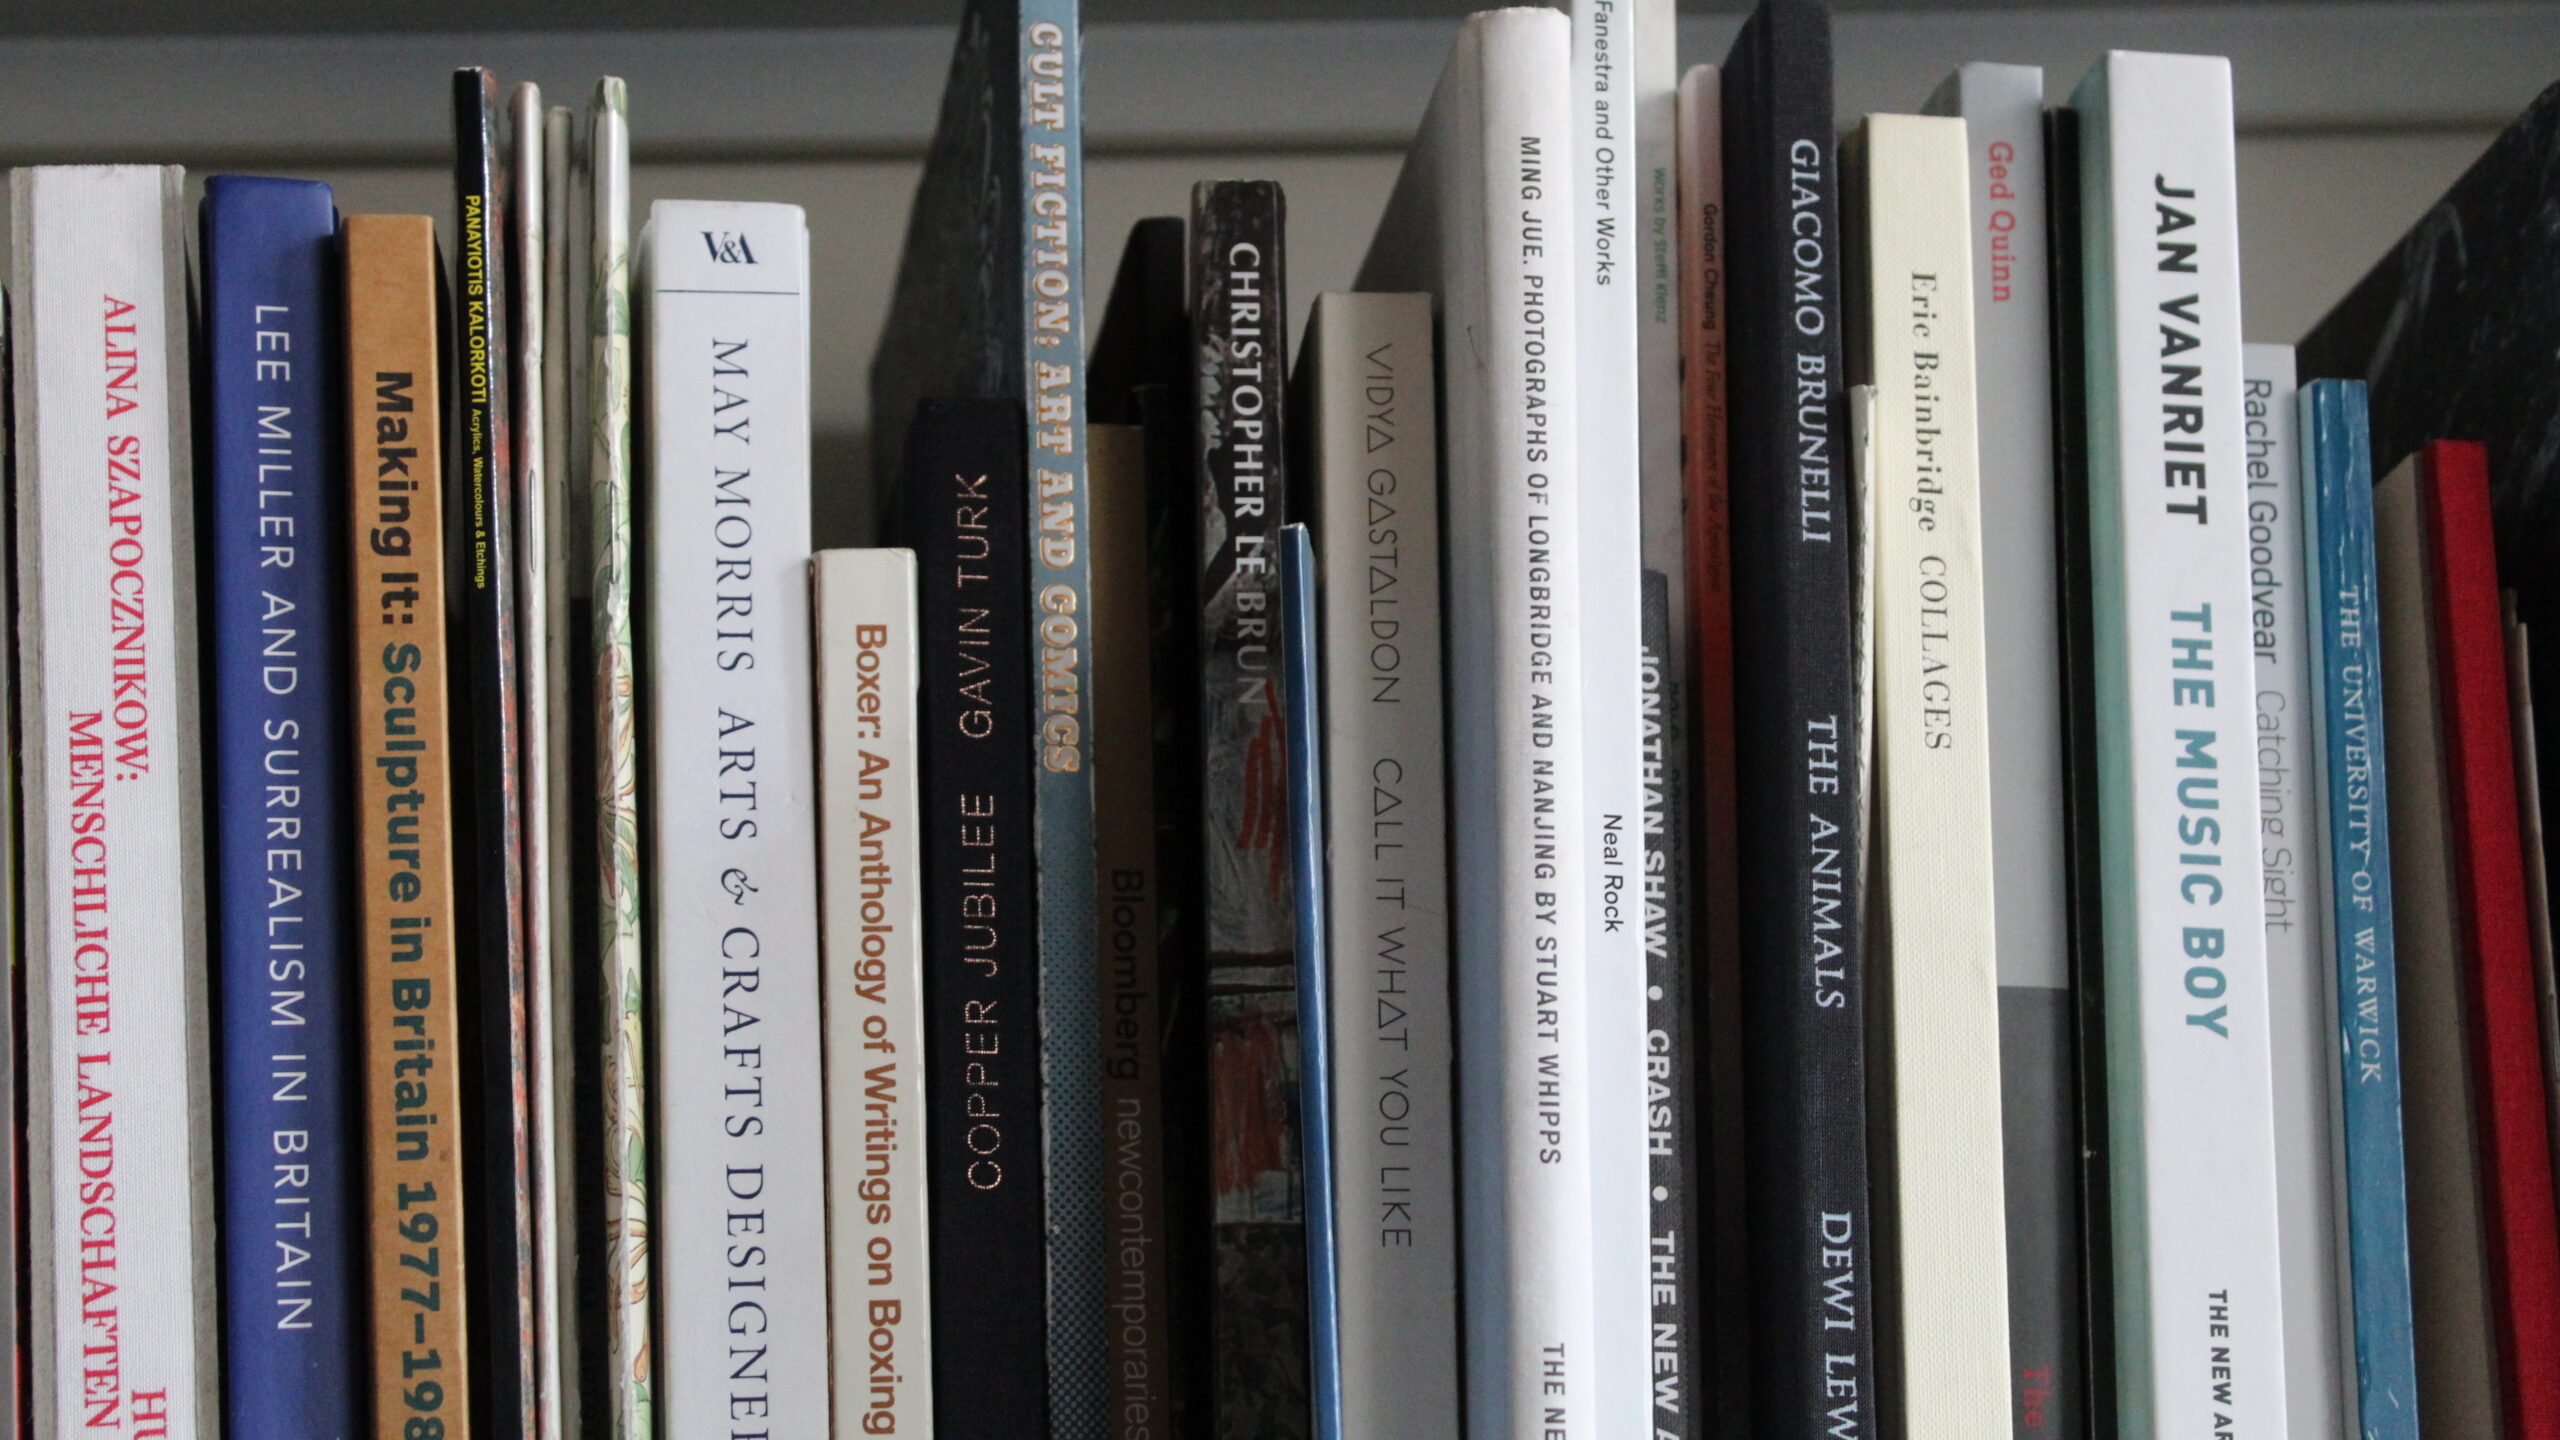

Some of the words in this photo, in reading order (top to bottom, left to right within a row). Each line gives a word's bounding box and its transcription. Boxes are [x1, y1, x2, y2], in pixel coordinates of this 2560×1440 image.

[1029, 21, 1064, 130] CULT
[1595, 0, 1613, 91] Fanestra
[1521, 136, 1542, 200] MING
[1595, 101, 1613, 140] and
[1988, 141, 2014, 199] Ged
[1595, 147, 1615, 210] Other
[1653, 168, 1667, 212] Works
[1653, 217, 1667, 236] by
[2155, 173, 2198, 273] JAN
[466, 195, 483, 295] PANAYIOTIS
[701, 231, 758, 264] V&A
[1031, 143, 1069, 347] FICTION:
[1522, 210, 1542, 265] JUE.
[1596, 218, 1616, 286] Works
[1703, 203, 1717, 263] Gordon
[1790, 138, 1825, 337] GIACOMO
[1988, 210, 2017, 302] Quinn
[255, 305, 290, 382] LEE
[468, 302, 487, 402] KALORKOTI
[1703, 269, 1718, 331] Cheung
[1911, 271, 1938, 337] Eric
[104, 294, 137, 419] ALINA
[712, 338, 750, 446] MAY
[1035, 361, 1073, 455] ART
[1229, 241, 1264, 518] CHRISTOPHER
[1523, 274, 1548, 462] PHOTOGRAPHS
[2159, 293, 2208, 525] VANRIET
[371, 371, 418, 557] Making
[471, 409, 483, 455] Acrylics,
[1797, 354, 1831, 543] BRUNELLI
[1910, 352, 1945, 533] Bainbridge
[2243, 378, 2279, 492] Rachel
[257, 406, 295, 569] MILLER
[473, 457, 484, 528] Watercolours
[955, 473, 988, 587] TURK
[1038, 468, 1075, 569] AND
[1527, 472, 1548, 505] OF
[107, 434, 149, 781] SZAPOCZNIKOW:
[381, 573, 420, 625] It:
[475, 542, 486, 588] Etchings
[714, 468, 754, 671] MORRIS
[1234, 535, 1265, 575] LE
[1528, 514, 1552, 684] LONGBRIDGE
[261, 591, 298, 695] AND
[1236, 592, 1268, 705] BRUN
[1919, 555, 1952, 751] COLLAGES
[2170, 602, 2215, 708] THE
[2339, 586, 2361, 648] THE
[856, 624, 887, 739] Boxer:
[958, 607, 992, 738] GAVIN
[1040, 583, 1080, 772] COMICS
[1532, 695, 1553, 748] AND
[376, 642, 426, 902] Sculpture
[717, 707, 757, 840] ARTS
[858, 750, 890, 799] An
[1641, 645, 1665, 836] JONATHAN
[1807, 714, 1839, 795] THE
[2255, 690, 2291, 838] Catching
[2341, 665, 2370, 858] UNIVERSITY
[1532, 759, 1556, 880] NANJING
[1603, 814, 1623, 865] Neal
[2175, 730, 2224, 907] MUSIC
[70, 710, 110, 1035] MENSCHLICHE
[264, 719, 306, 1027] SURREALISM
[720, 868, 759, 905] &
[854, 811, 893, 1004] Anthology
[961, 794, 996, 977] JUBILEE
[1376, 879, 1404, 910] IT
[1535, 891, 1557, 924] BY
[1604, 875, 1624, 933] Rock
[1645, 850, 1668, 959] SHAW
[1810, 814, 1846, 1009] ANIMALS
[2262, 849, 2293, 932] Sight
[2351, 872, 2373, 912] OF
[389, 917, 432, 962] in
[1107, 869, 1145, 1082] Bloomberg
[1536, 935, 1558, 1043] STUART
[2182, 926, 2229, 1039] BOY
[721, 927, 763, 1138] CRAFTS
[862, 1014, 893, 1055] of
[2352, 927, 2381, 1083] WARWICK
[272, 1054, 307, 1102] IN
[391, 978, 435, 1161] Britain
[964, 1000, 1001, 1190] COPPER
[1379, 1070, 1410, 1146] YOU
[1538, 1053, 1561, 1165] WHIPPS
[1647, 1028, 1673, 1156] CRASH
[857, 1060, 898, 1225] Writings
[77, 1051, 121, 1429] LANDSCHAFTEN
[273, 1129, 312, 1330] BRITAIN
[1381, 1168, 1412, 1247] LIKE
[868, 1237, 892, 1286] on
[1111, 1100, 1154, 1440] newcontemporaries
[1651, 1231, 1676, 1306] THE
[1821, 1211, 1855, 1332] DEWI
[2209, 1289, 2229, 1338] THE
[861, 1298, 902, 1436] Boxing
[1543, 1342, 1565, 1396] THE
[1653, 1323, 1679, 1414] NEW
[2023, 1364, 2050, 1429] The
[2211, 1347, 2232, 1405] NEW
